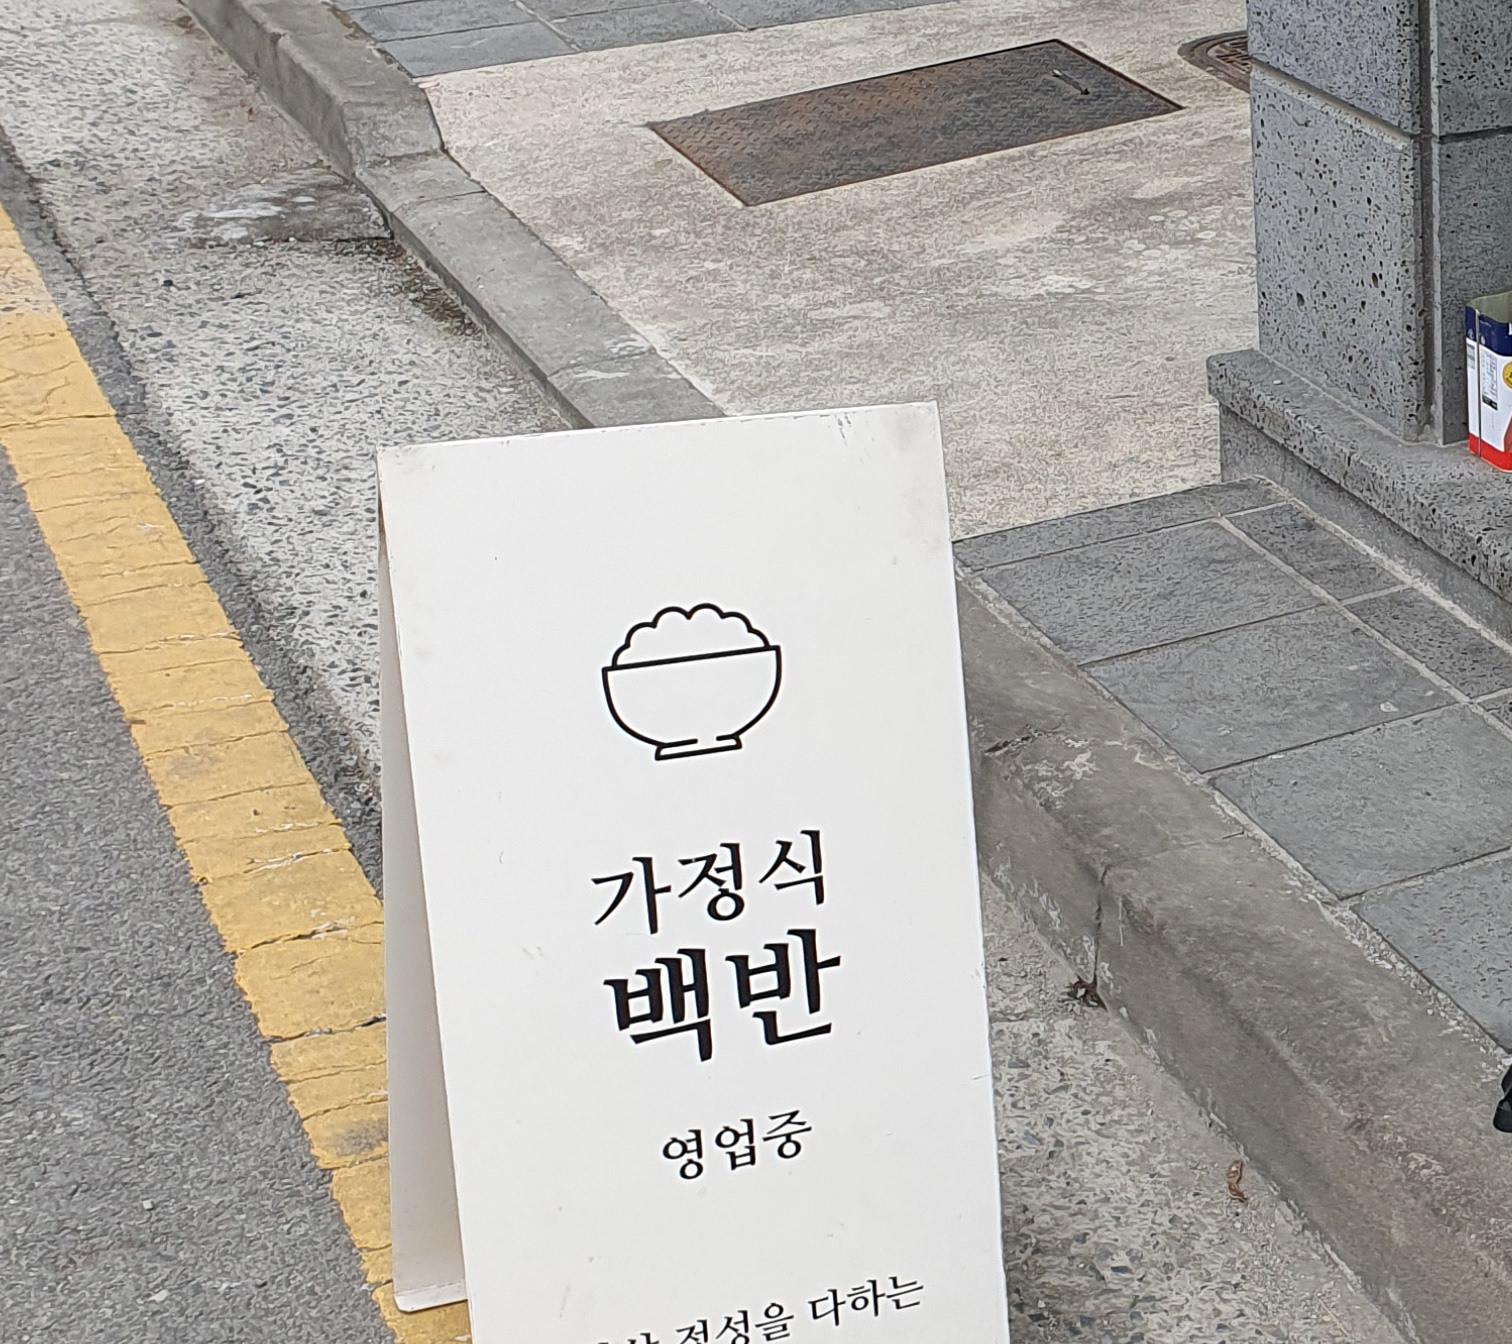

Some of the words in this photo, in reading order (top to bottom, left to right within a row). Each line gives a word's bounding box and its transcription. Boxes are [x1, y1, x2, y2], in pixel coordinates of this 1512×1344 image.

[590, 829, 825, 935] 가정식
[602, 928, 842, 1063] 백반
[661, 1109, 813, 1180] 영업중
[807, 1275, 925, 1327] 다하는
